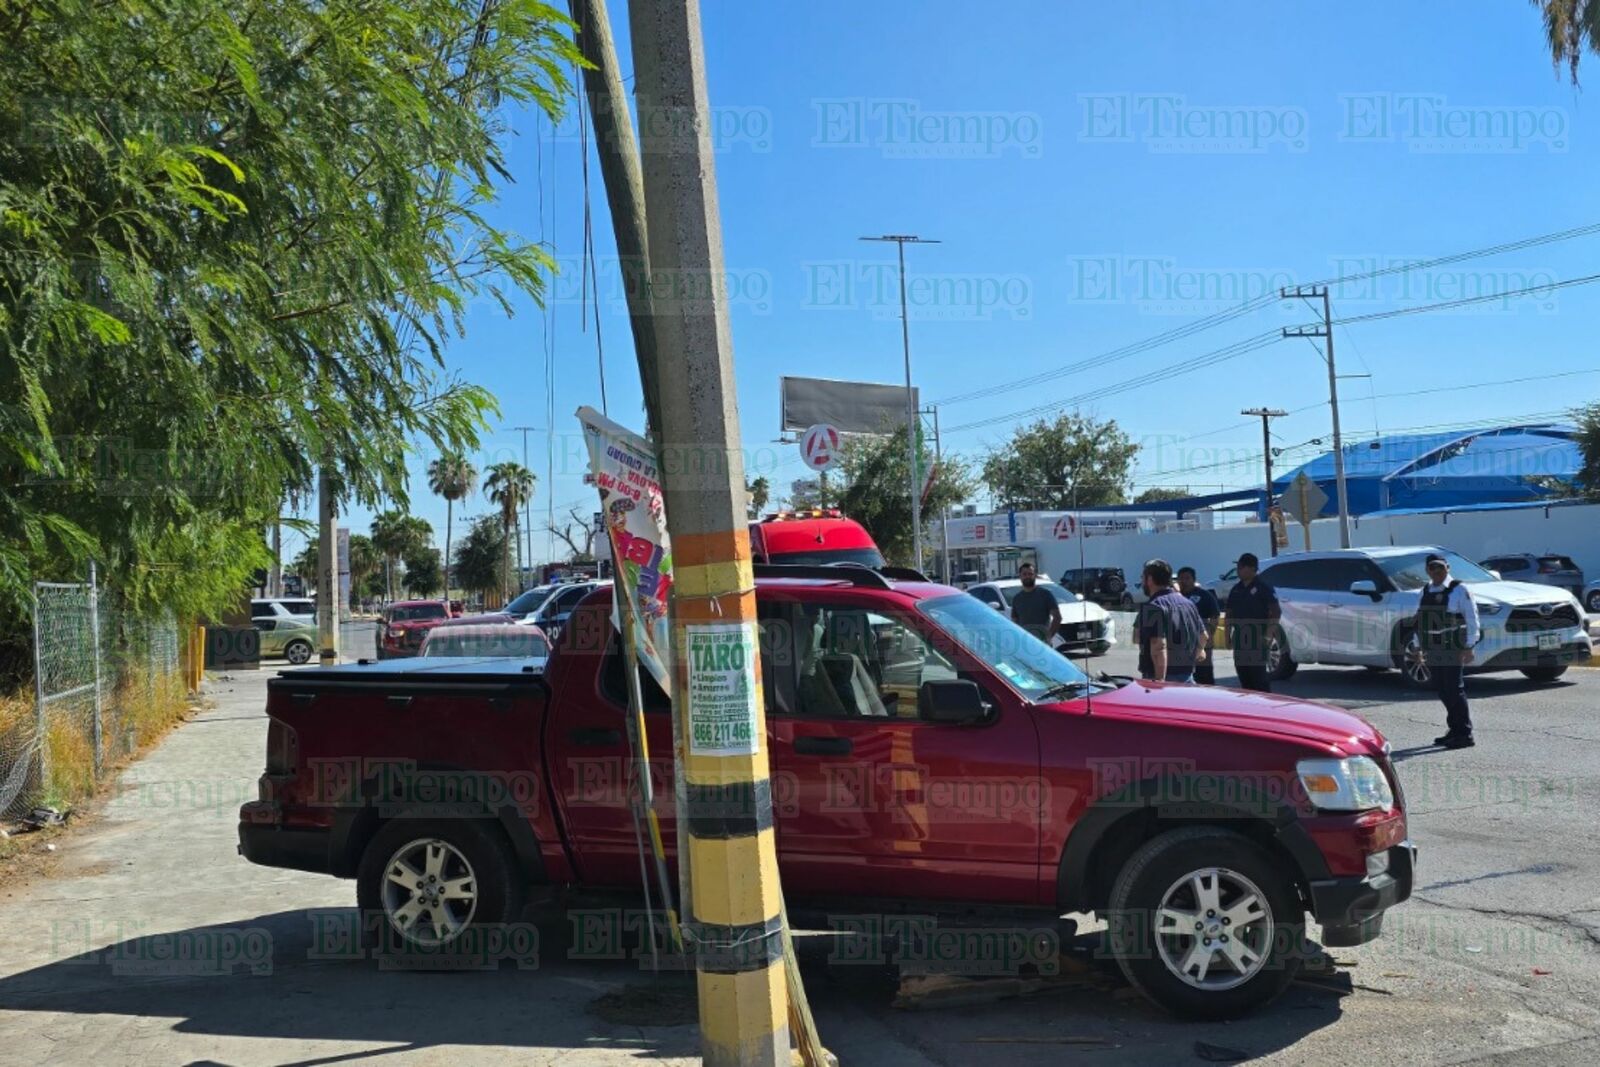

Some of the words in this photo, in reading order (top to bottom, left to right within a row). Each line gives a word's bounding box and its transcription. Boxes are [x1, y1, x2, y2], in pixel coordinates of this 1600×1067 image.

[607, 446, 642, 471] CIUDAD
[691, 643, 753, 672] TAROT
[714, 723, 730, 741] 211
